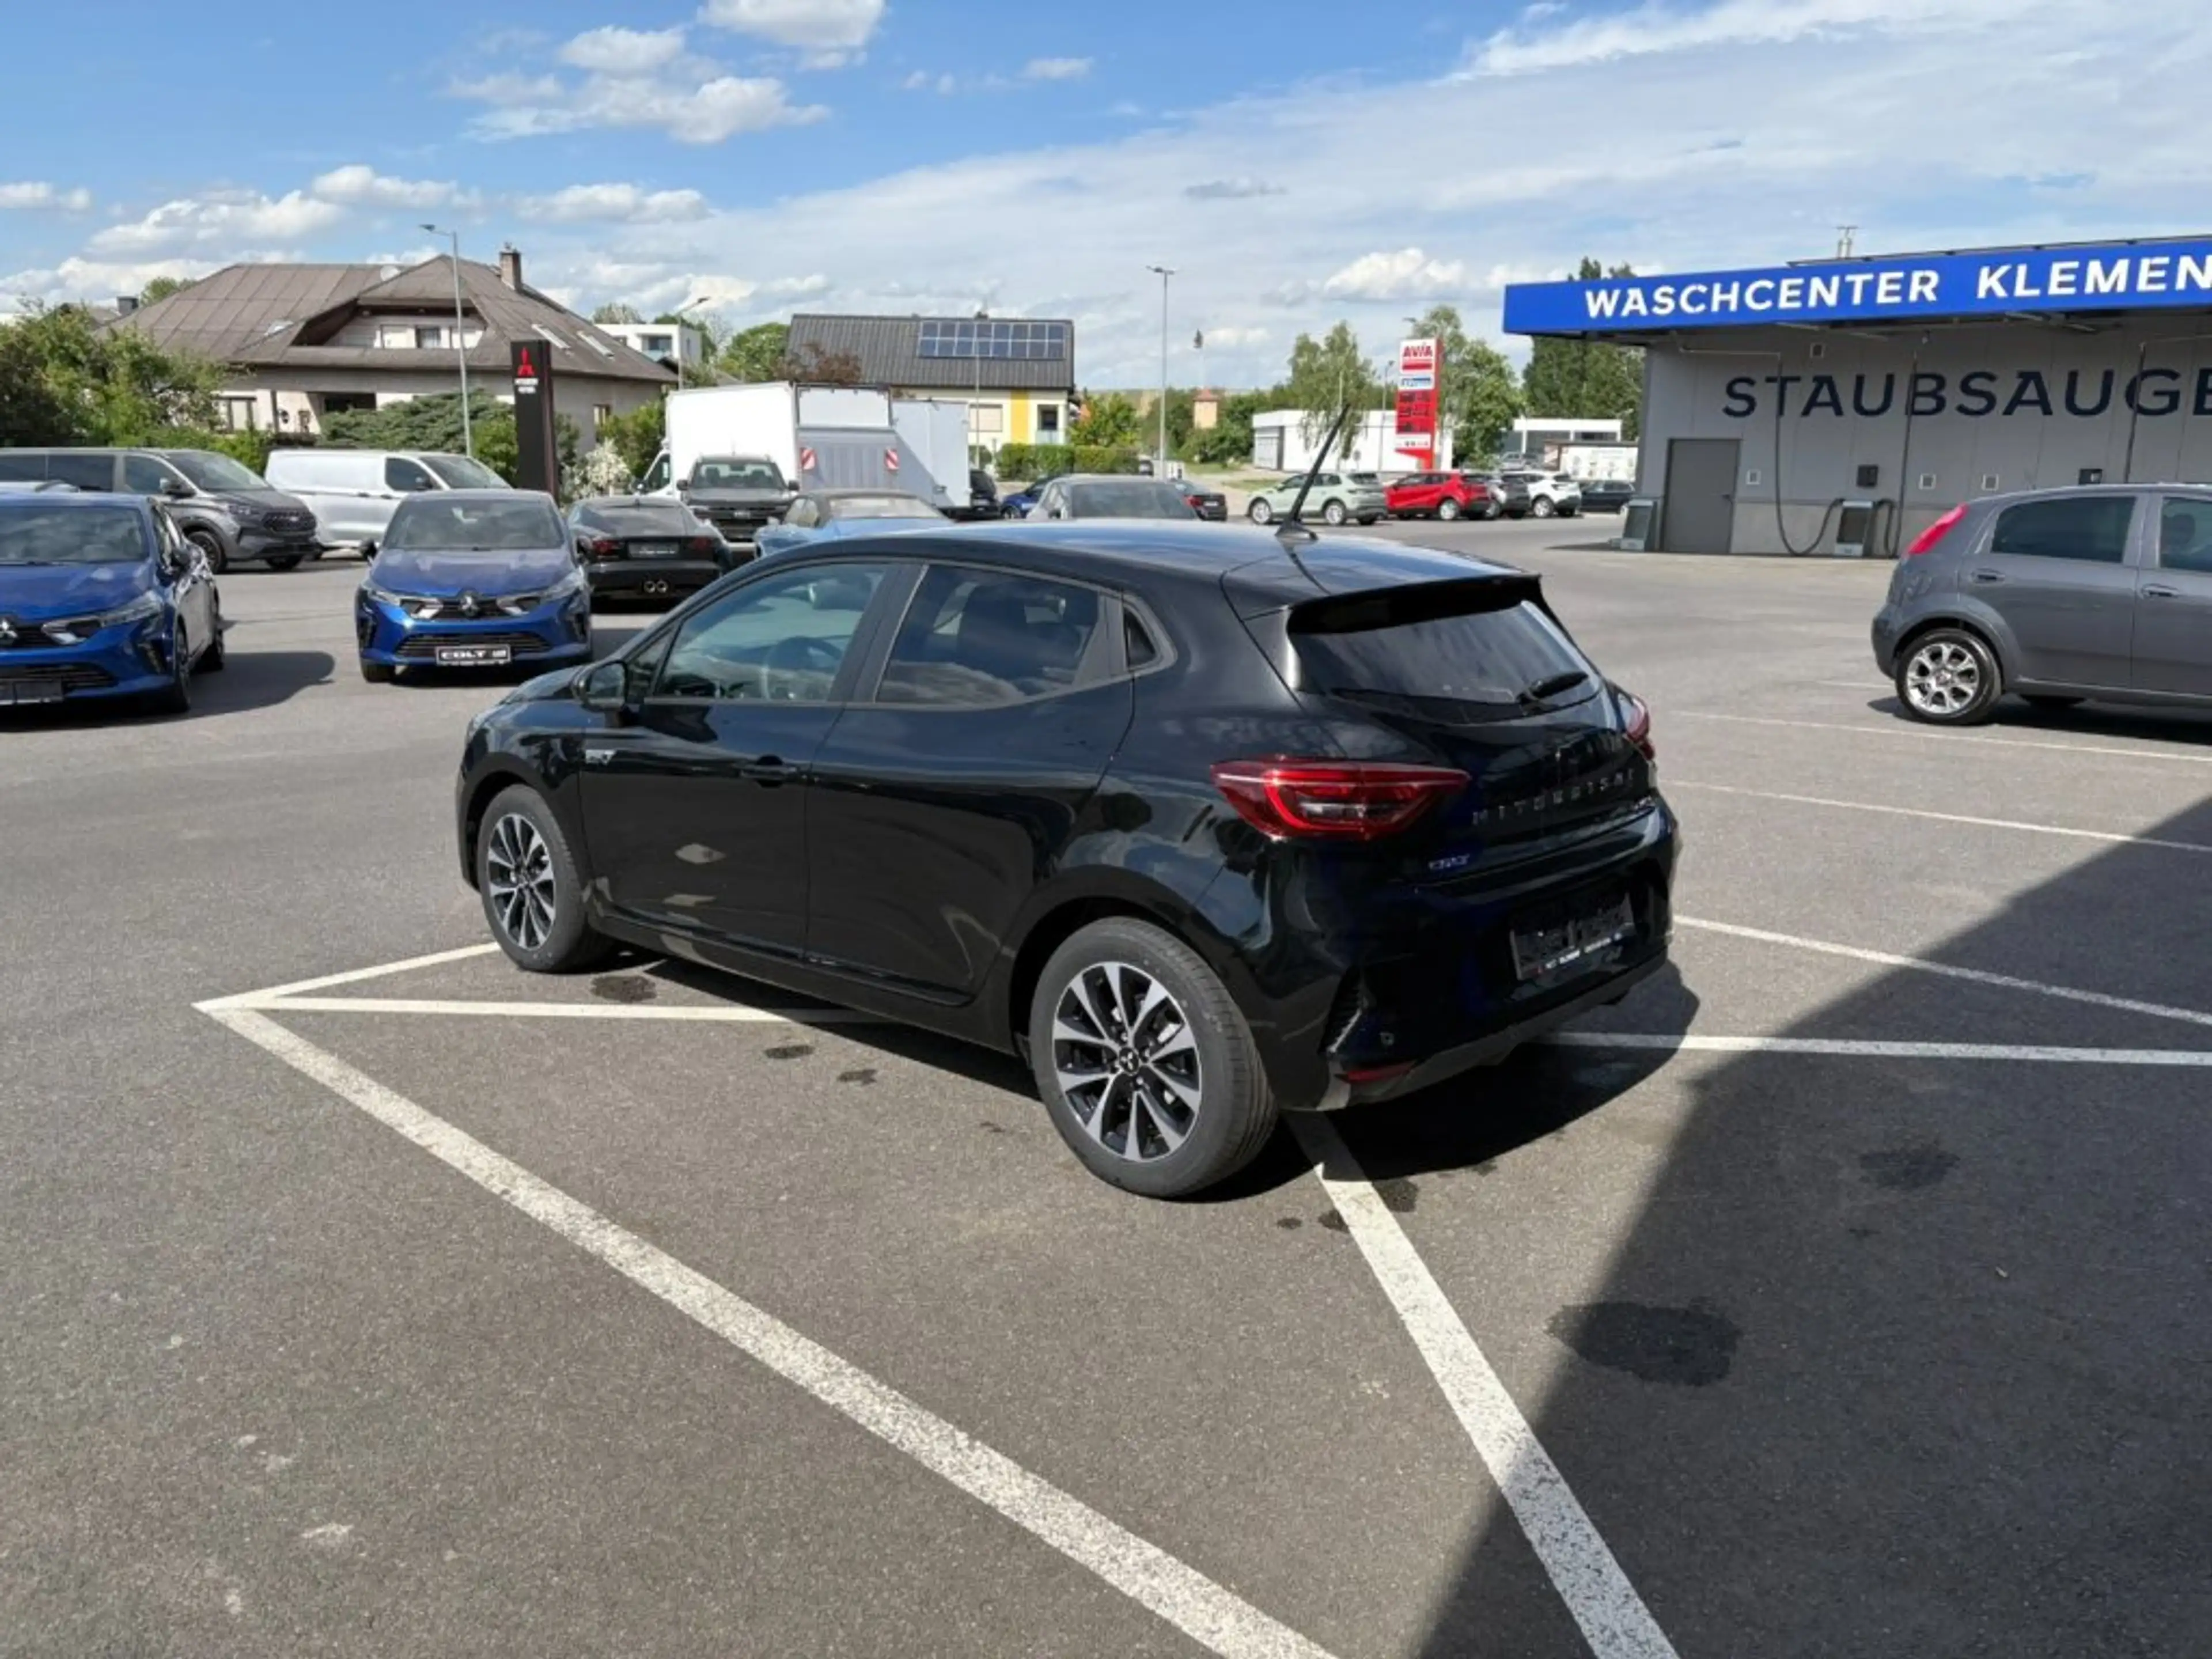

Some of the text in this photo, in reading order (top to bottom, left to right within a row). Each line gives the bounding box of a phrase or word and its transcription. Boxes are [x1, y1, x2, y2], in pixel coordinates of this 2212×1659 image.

[1585, 255, 2212, 319] WASCHCENTER KLEMEN
[1403, 346, 1433, 357] AVIA
